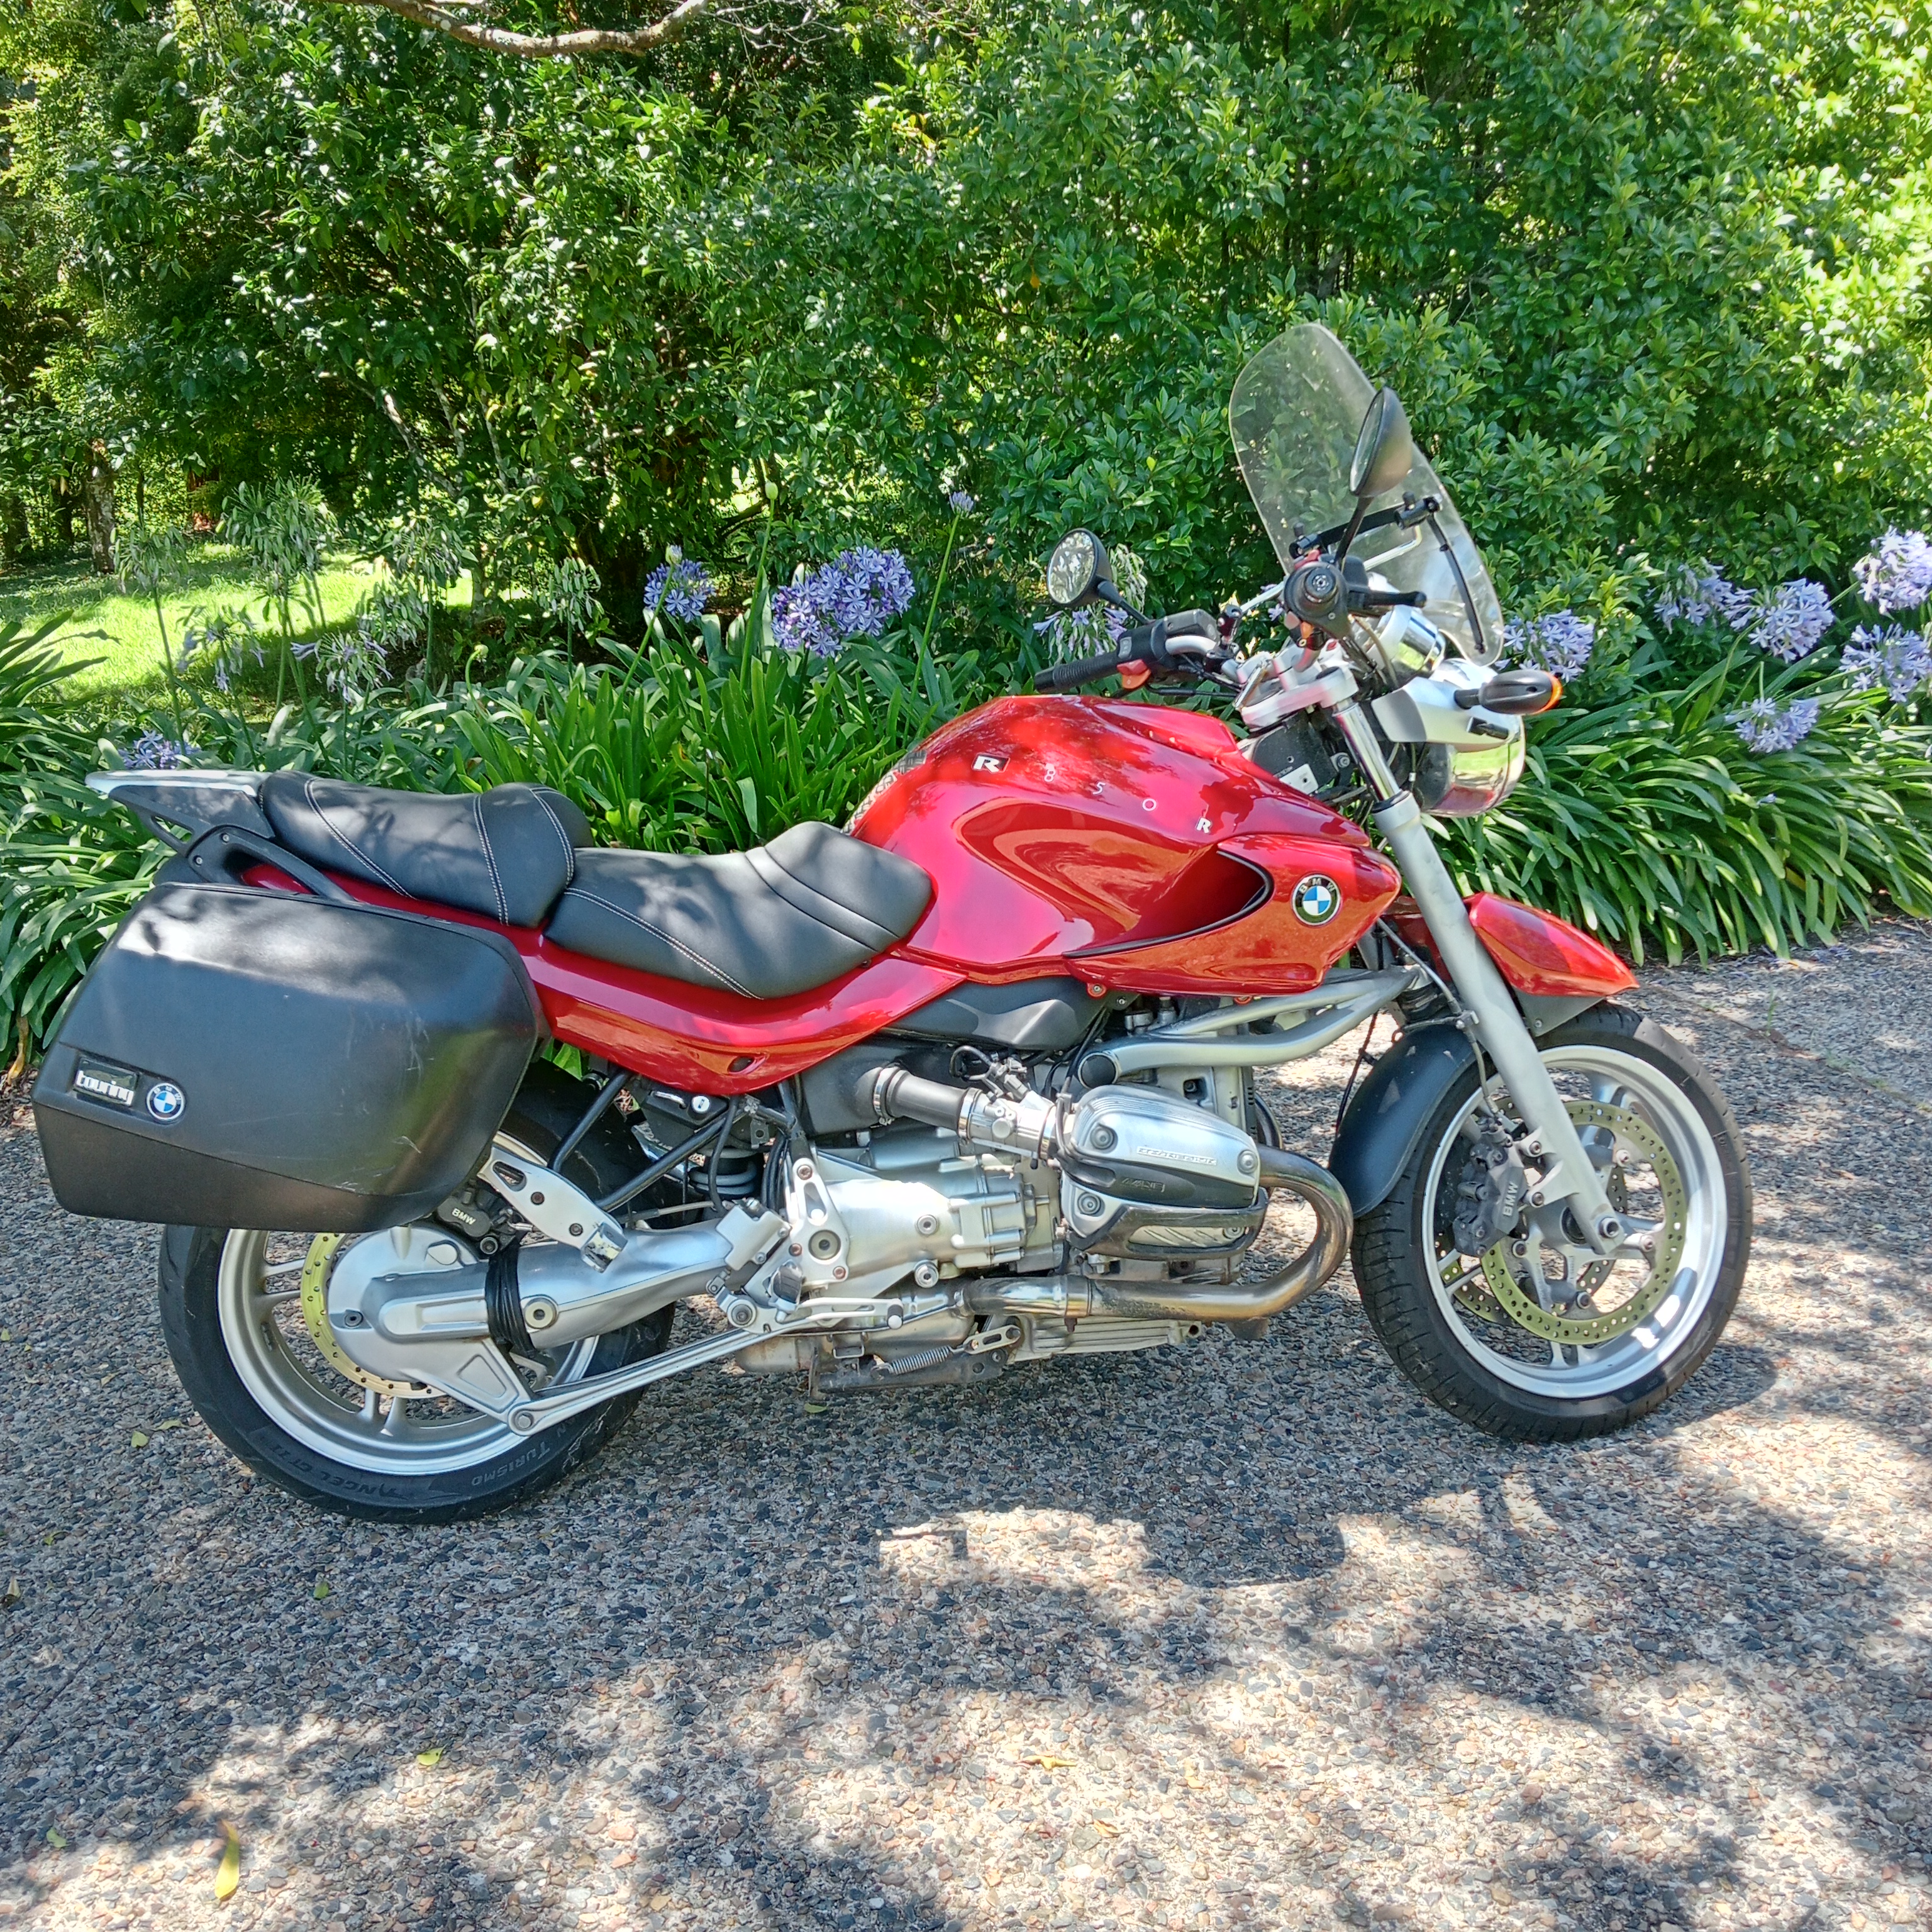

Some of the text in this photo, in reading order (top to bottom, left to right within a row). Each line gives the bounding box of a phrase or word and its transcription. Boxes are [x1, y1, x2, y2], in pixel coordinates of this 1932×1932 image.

[75, 1070, 134, 1106] touring
[1502, 1182, 1519, 1216] BMW
[452, 1208, 476, 1225] BMW
